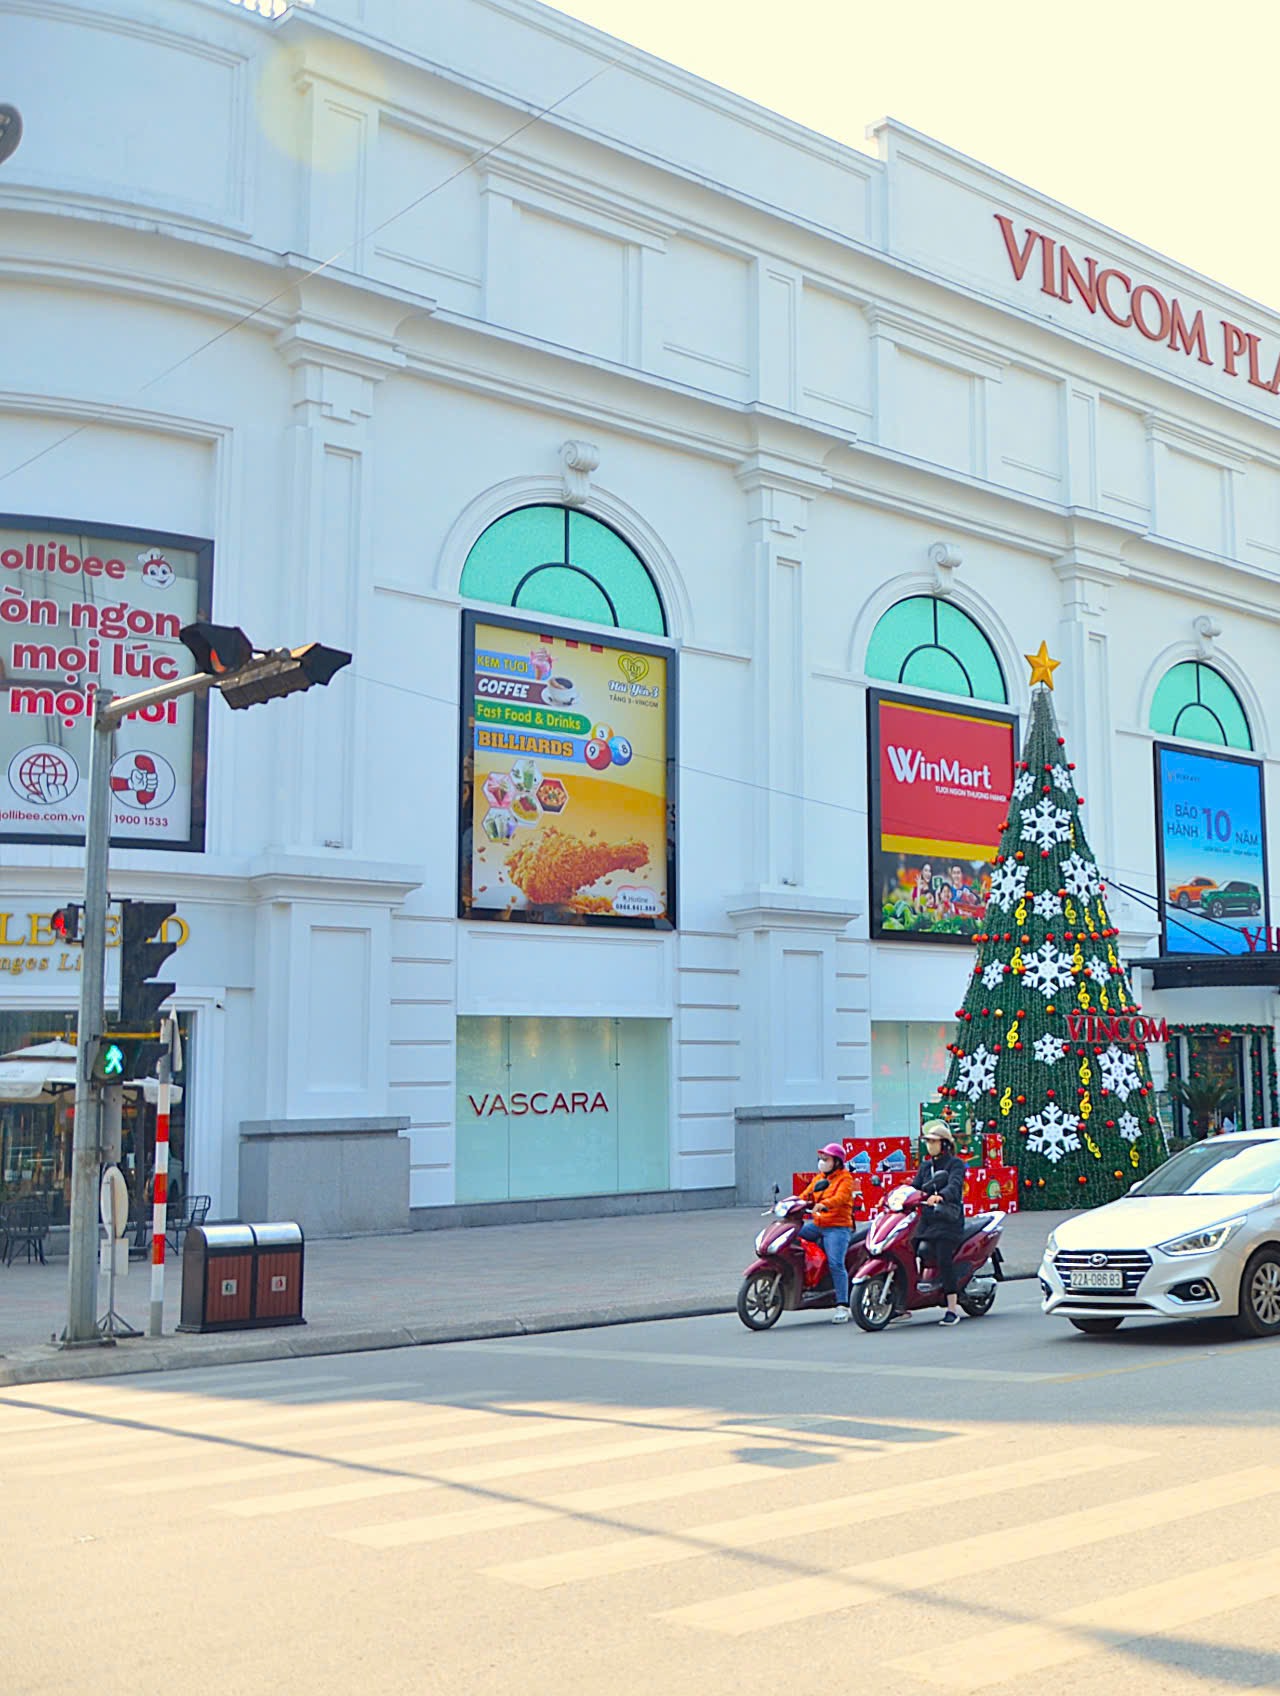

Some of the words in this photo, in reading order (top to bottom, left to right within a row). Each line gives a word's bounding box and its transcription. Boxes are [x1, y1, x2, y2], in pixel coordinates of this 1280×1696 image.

[994, 213, 1214, 366] VINCOM
[71, 602, 181, 640] ngon
[13, 637, 100, 684] mọi
[113, 643, 179, 681] lúc
[477, 655, 500, 668] KEM
[478, 678, 530, 699] COFFEE
[650, 686, 660, 698] 3
[10, 682, 96, 728] mọi
[477, 703, 502, 720] Fast
[504, 708, 532, 724] Food
[535, 713, 545, 725] &
[547, 714, 581, 731] Drinks
[478, 731, 574, 758] BILLIARDS
[589, 744, 597, 756] 9
[621, 743, 629, 755] 8
[887, 745, 992, 789] WinMart
[114, 814, 140, 825] 1900
[144, 816, 168, 827] 1533
[1175, 801, 1198, 819] BẢO
[1167, 820, 1199, 838] HÀNH
[1202, 808, 1232, 842] 10
[1235, 829, 1259, 846] NĂM
[1063, 1014, 1170, 1043] VINCOM
[468, 1091, 609, 1117] VASCARA
